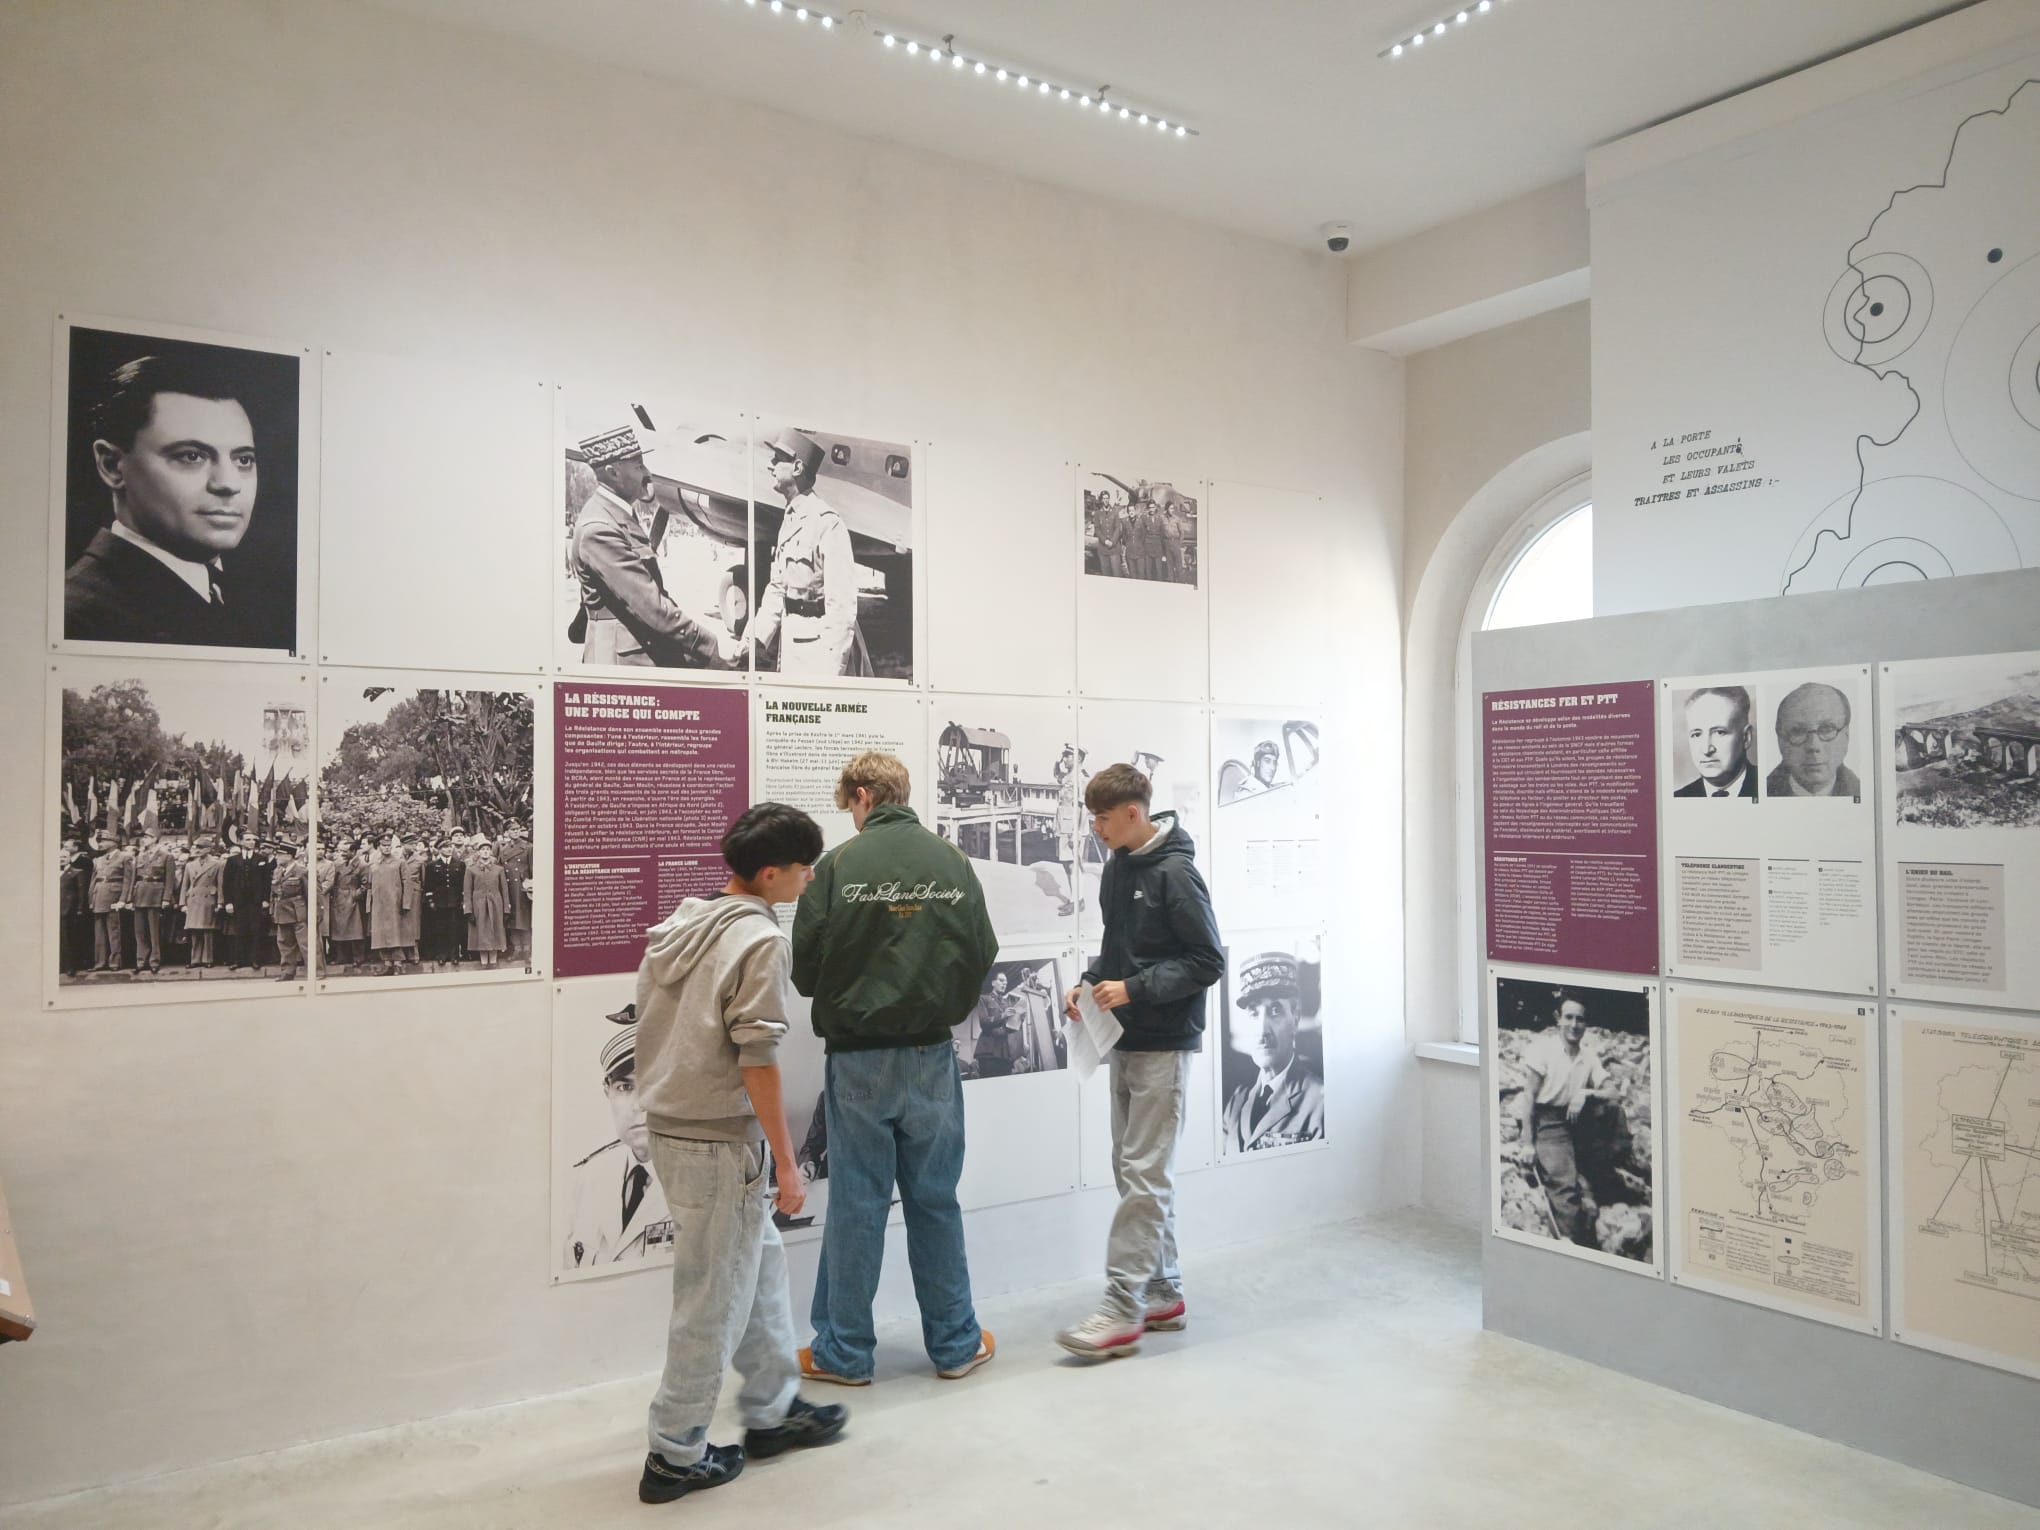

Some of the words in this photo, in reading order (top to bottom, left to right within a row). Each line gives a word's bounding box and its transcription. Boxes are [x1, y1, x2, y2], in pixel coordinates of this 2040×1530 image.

[1651, 441, 1656, 450] A
[1663, 438, 1674, 447] LA
[1680, 430, 1712, 444] PORTE
[1662, 454, 1681, 466] LES
[1686, 443, 1742, 461] OCCUPANTS
[1662, 474, 1675, 484] ET
[1680, 468, 1711, 480] LEURS
[1717, 460, 1755, 474] VALETS
[1634, 491, 1681, 506] TRAITRES
[1686, 488, 1699, 498] ET
[1704, 478, 1762, 496] ASSASSINS
[565, 693, 580, 704] LA
[766, 701, 778, 710] LA
[782, 702, 832, 712] NOUVELLE
[835, 703, 868, 713] ARMÉE
[1559, 696, 1578, 707] FER
[1581, 695, 1594, 706] ET
[1597, 694, 1618, 705] PTT
[565, 706, 589, 718] UNE
[592, 708, 629, 719] FORCE
[632, 709, 652, 720] QUI
[655, 710, 700, 721] COMPTE
[766, 714, 821, 725] FRANÇAISE
[914, 881, 966, 905] Society
